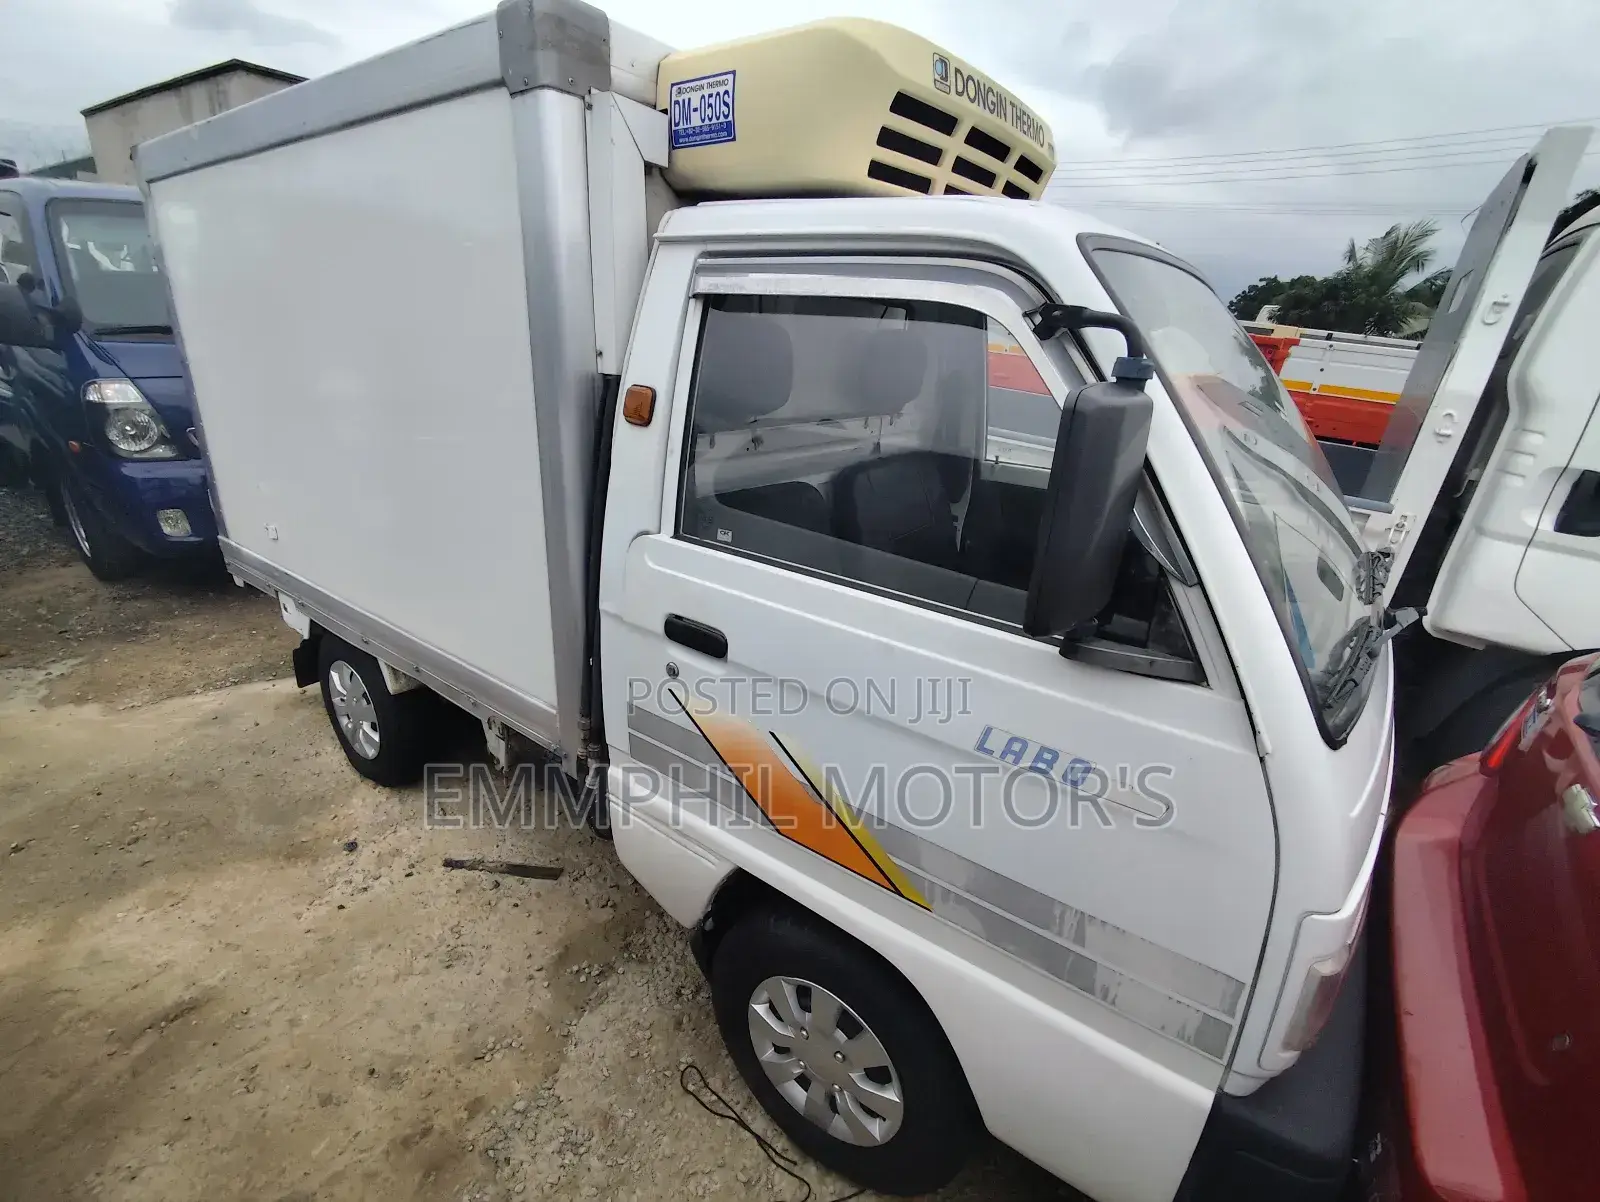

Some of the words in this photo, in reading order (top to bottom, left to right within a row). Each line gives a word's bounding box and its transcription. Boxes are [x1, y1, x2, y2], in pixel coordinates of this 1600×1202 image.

[673, 89, 731, 128] DM-050S
[681, 84, 705, 95] DONGIN
[706, 78, 729, 90] THERMO
[954, 66, 1008, 123] DONGIN
[1009, 100, 1045, 148] THERMO
[975, 726, 1094, 788] LABO
